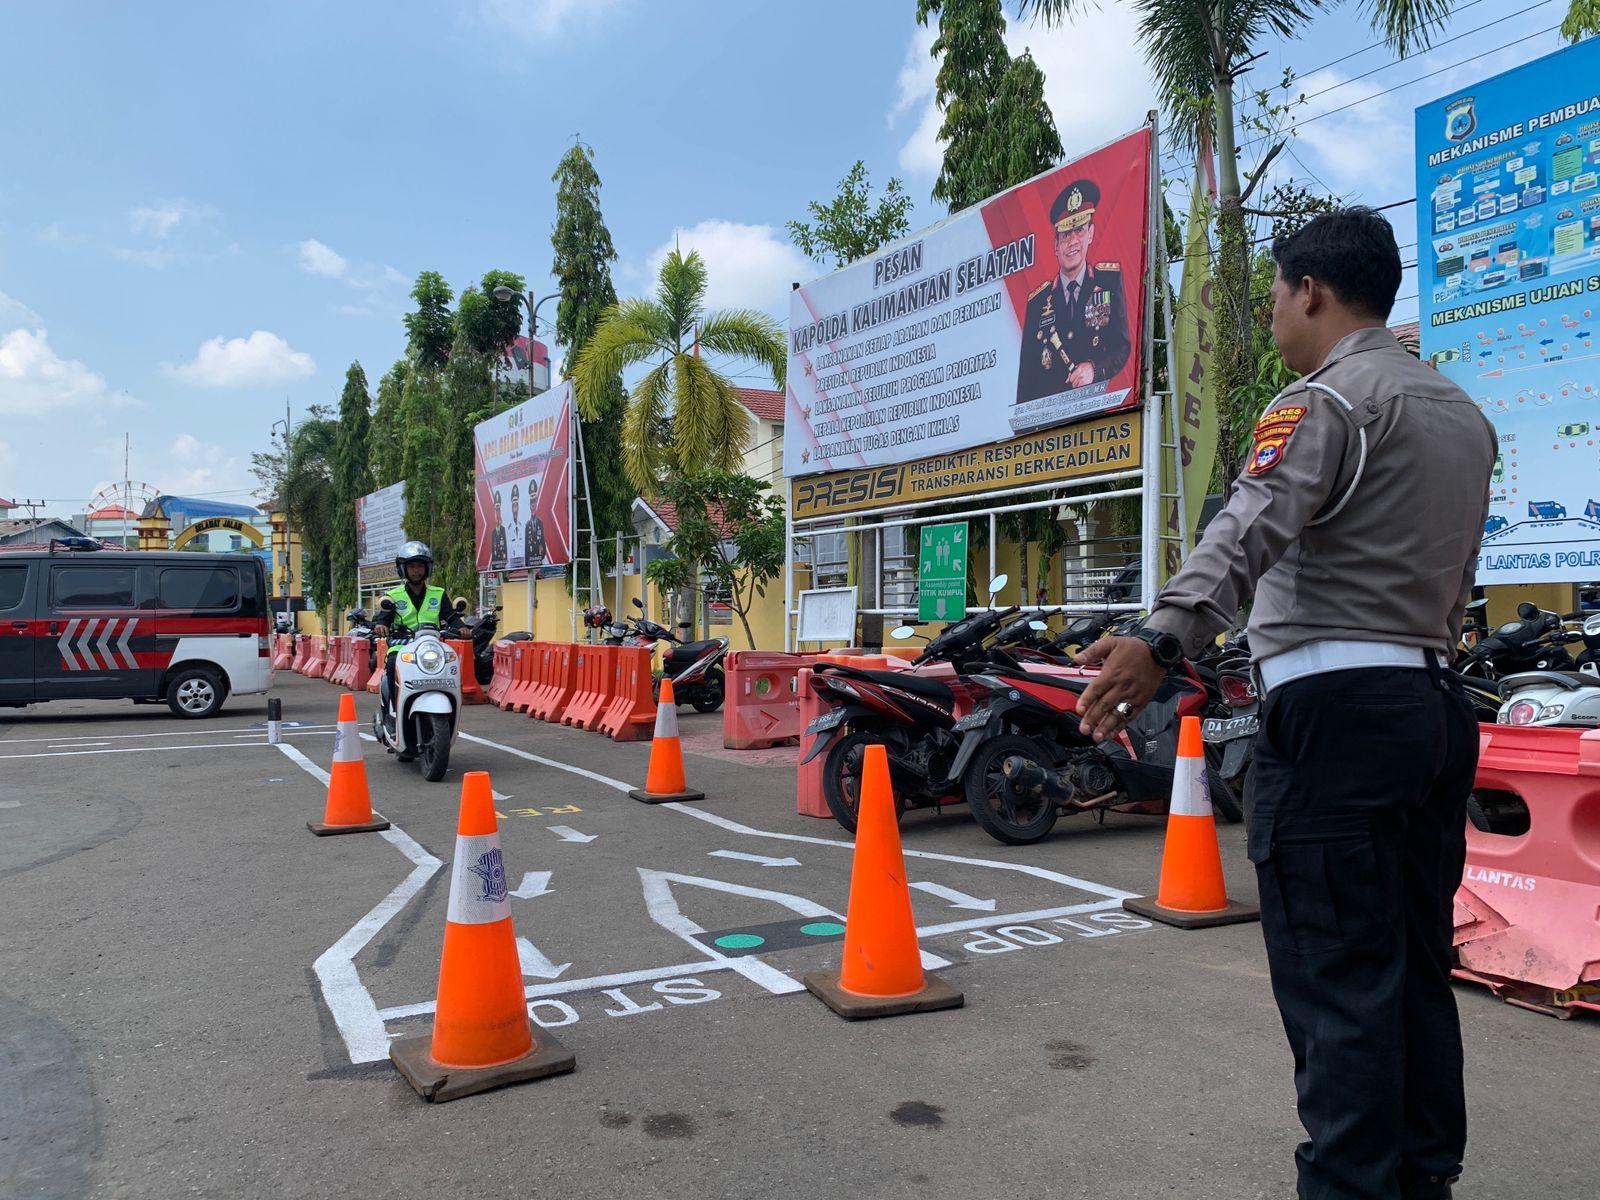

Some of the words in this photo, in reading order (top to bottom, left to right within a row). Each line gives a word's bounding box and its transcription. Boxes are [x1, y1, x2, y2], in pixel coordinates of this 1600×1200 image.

[1427, 124, 1524, 167] MEKANISME
[874, 240, 923, 288] PESAN
[793, 315, 848, 355] KAPOLDA
[852, 270, 951, 334] KALIMANTAN
[956, 234, 1036, 295] SELATAN
[1431, 292, 1526, 327] MEKANISME
[1529, 277, 1583, 305] UJIAN
[816, 343, 863, 371] LAKSANAKAN
[865, 333, 892, 355] SETIAP
[893, 319, 929, 348] ARAHAN
[930, 311, 951, 330] DAN
[953, 293, 1002, 325] PERINTAH
[815, 370, 849, 393] PRESIDEN
[851, 359, 888, 384] REPUBLIK
[889, 344, 937, 367] INDONESIA
[815, 392, 862, 416] LAKSANAKAN
[864, 384, 899, 405] SELURUH
[901, 368, 944, 392] PROGRAM
[946, 349, 997, 381] PRIORITAS
[813, 418, 840, 438] KEPALA
[841, 405, 886, 433] KEPOLISIAN
[888, 399, 929, 423] REPUBLIK
[930, 382, 981, 410] INDONESIA
[813, 437, 861, 461] LAKSANAKAN
[862, 432, 889, 451] TUGAS
[891, 426, 926, 448] DENGAN
[927, 415, 960, 438] IKHLAS
[984, 423, 1132, 462] RESPONSIBILITAS
[796, 464, 906, 512] PRESISI
[911, 465, 1009, 492] TRANSPARANSI
[1014, 443, 1131, 477] BERKEADILAN
[195, 519, 220, 532] SELAMAT
[223, 519, 243, 531] JALAN
[1486, 552, 1551, 570] LANTAS
[921, 589, 937, 597] TITIK
[937, 588, 964, 597] KUMPUL
[1208, 721, 1222, 731] DA
[1466, 866, 1536, 892] LANTAS
[963, 911, 1153, 954] STOP
